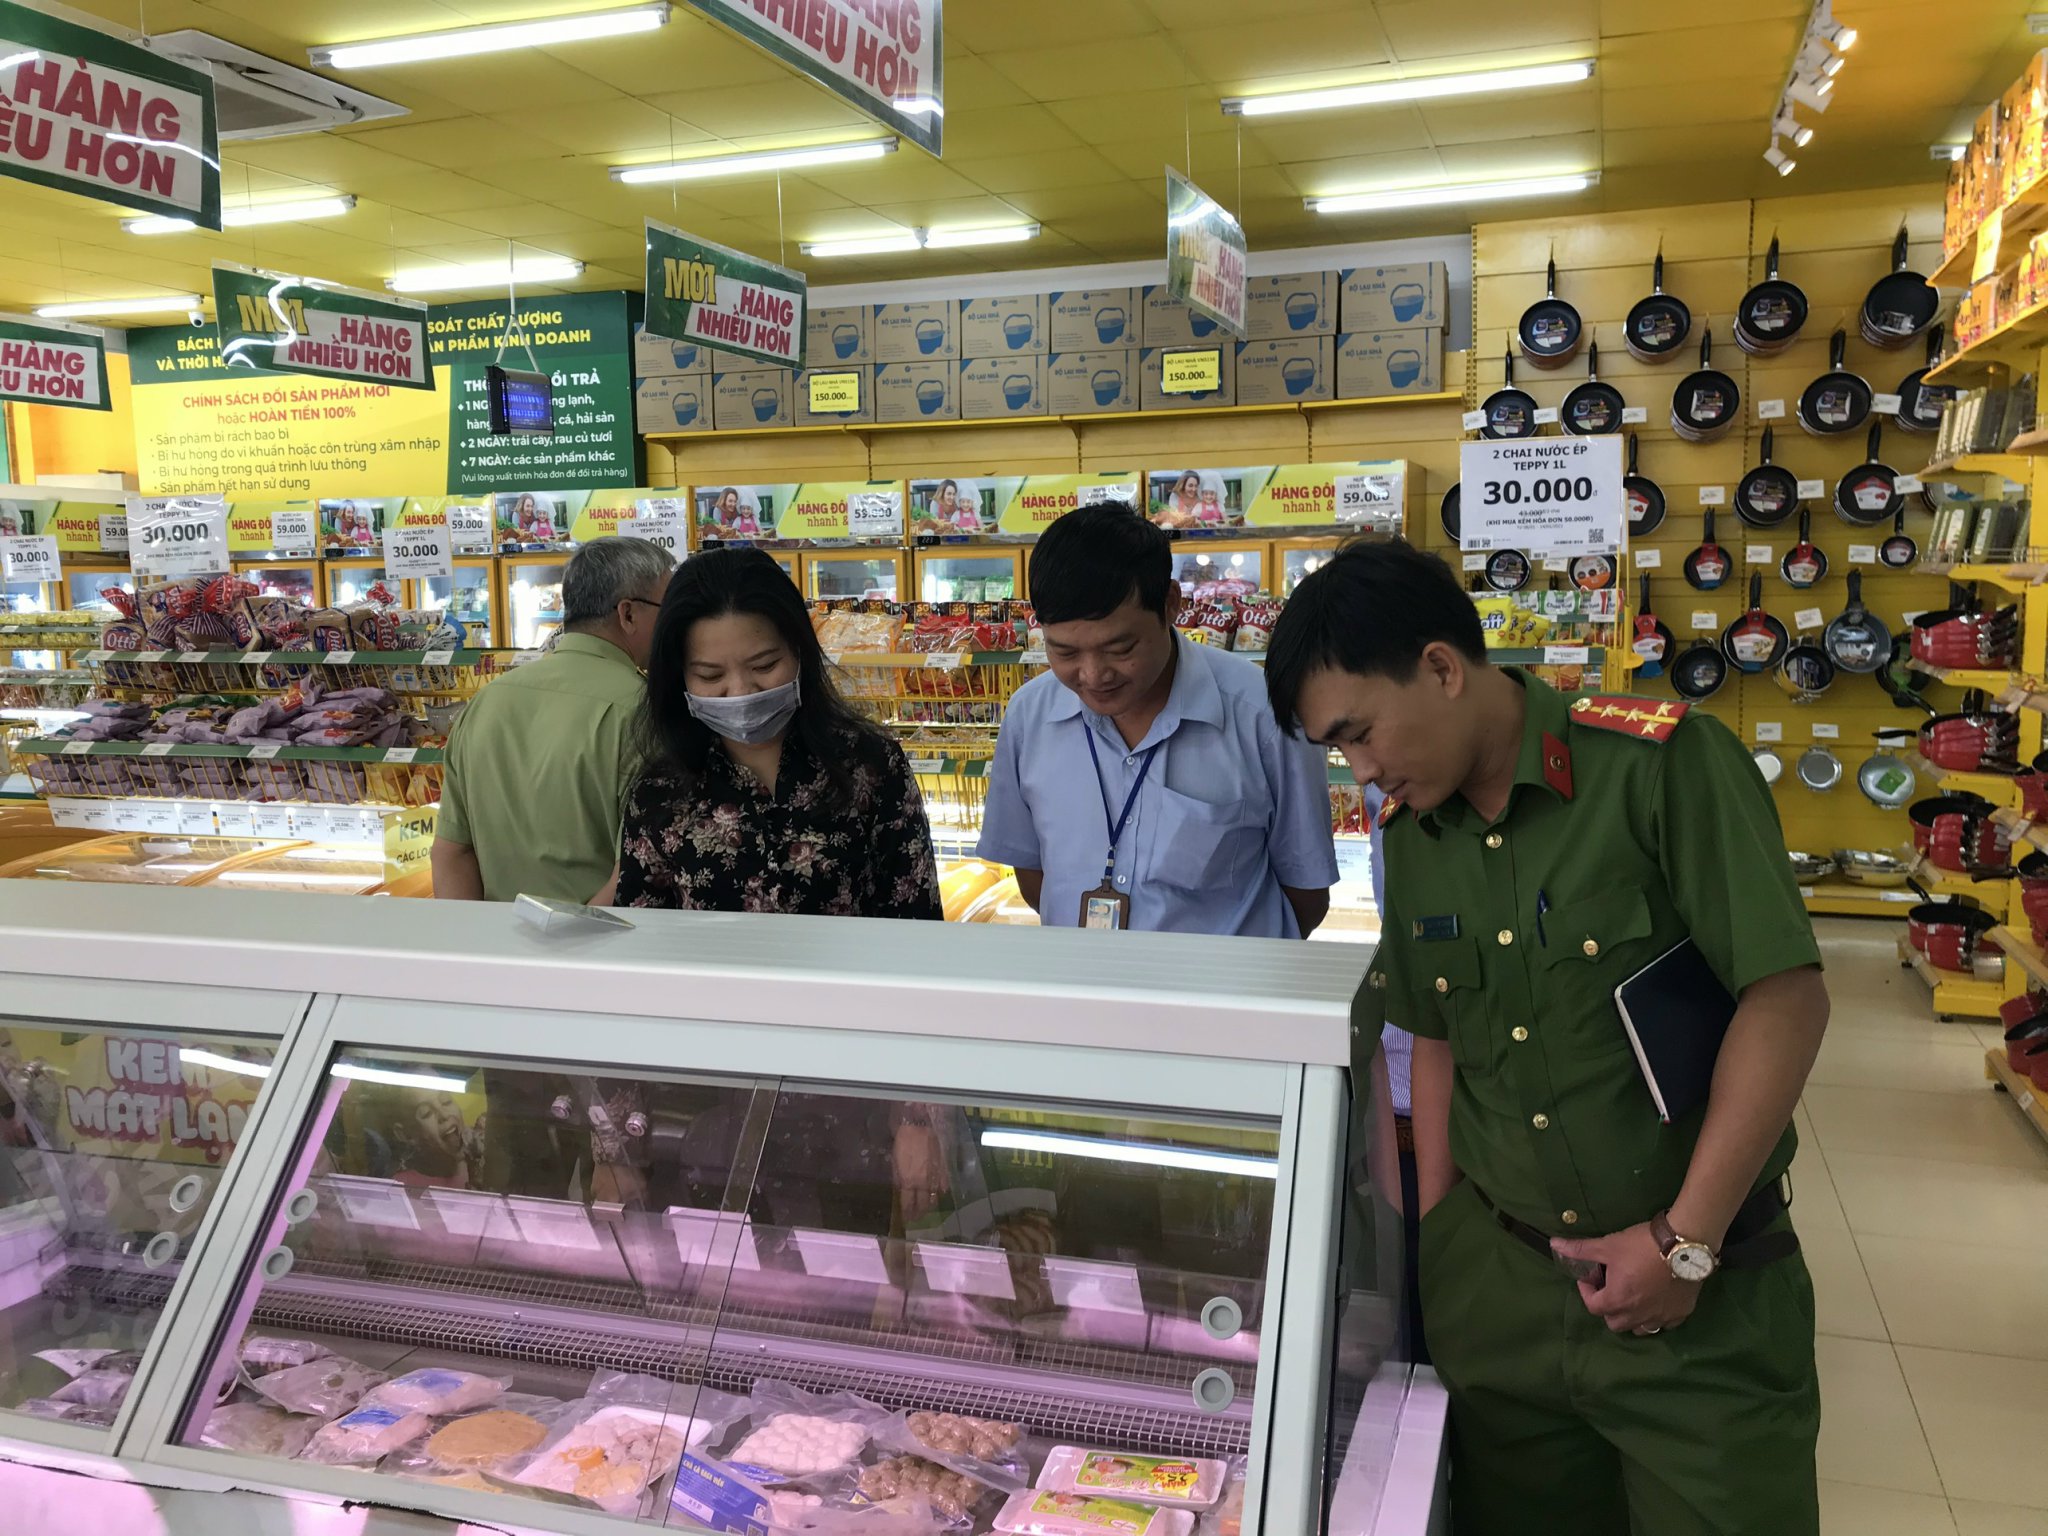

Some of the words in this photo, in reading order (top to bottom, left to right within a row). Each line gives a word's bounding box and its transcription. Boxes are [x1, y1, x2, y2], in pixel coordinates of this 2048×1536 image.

[847, 0, 921, 54] NG
[854, 25, 918, 102] HƠN
[13, 56, 181, 143] HÀNG
[65, 126, 175, 197] HƠN
[663, 254, 717, 305] MỚI
[740, 284, 794, 327] HÀNG
[427, 317, 463, 333] SOÁT
[467, 311, 505, 331] CHẤT
[696, 304, 752, 345] NHIỀU
[753, 323, 791, 355] HƠN
[340, 315, 412, 353] HÀNG
[429, 338, 444, 353] ẢN
[448, 333, 490, 351] PHẨM
[493, 332, 531, 349] KINH
[535, 329, 591, 345] DOANH
[177, 337, 213, 352] BÁCH
[1, 340, 85, 375] HÀNG
[156, 356, 174, 371] VÀ
[180, 354, 209, 369] THỜI
[288, 334, 358, 371] NHIỀU
[364, 350, 411, 378] HƠN
[551, 370, 568, 386] ỔI
[571, 368, 600, 385] TRẢ
[1169, 371, 1205, 381] 150.000
[28, 373, 83, 399] HƠN
[183, 393, 222, 408] CHÍNH
[225, 390, 259, 405] SÁCH
[262, 387, 287, 403] ĐỔI
[321, 383, 360, 399] PHẨM
[568, 394, 595, 407] lạnh,
[815, 392, 847, 401] 150.000
[217, 413, 246, 424] hoặc
[249, 407, 288, 423] HOÀN
[290, 406, 320, 421] TIỀN
[323, 406, 356, 419] 100%
[559, 414, 574, 426] cá,
[577, 412, 592, 423] hải
[595, 412, 615, 423] sản
[254, 429, 275, 440] bao
[468, 438, 475, 448] 2
[477, 435, 510, 447] NGÀY:
[512, 435, 530, 446] trái
[555, 436, 572, 444] rau
[576, 433, 588, 443] củ
[591, 431, 612, 442] tươi
[220, 447, 234, 458] do
[237, 447, 247, 458] vi
[288, 443, 316, 456] hoặc
[320, 442, 341, 454] côn
[344, 440, 376, 454] trùng
[380, 440, 407, 451] xâm
[409, 437, 440, 452] nhập
[1493, 450, 1500, 459] 2
[1503, 448, 1532, 459] CHAI
[1535, 444, 1570, 457] NƯỚC
[1573, 443, 1588, 455] ÉP
[222, 464, 251, 476] trong
[255, 462, 276, 475] quá
[279, 460, 306, 472] trình
[310, 459, 328, 471] lưu
[331, 457, 367, 471] thông
[469, 457, 476, 467] 7
[478, 454, 511, 467] NGÀY:
[513, 455, 531, 465] các
[534, 453, 552, 465] sản
[555, 452, 586, 466] phẩm
[588, 451, 615, 461] khác
[1513, 460, 1549, 471] TEPPY
[1553, 460, 1566, 469] 1L
[279, 476, 310, 490] dụng
[476, 473, 494, 483] lòng
[603, 467, 627, 477] hàng)
[1271, 484, 1310, 500] HÀNG
[1483, 477, 1592, 505] 30.000
[797, 500, 828, 515] HÀNG
[1022, 493, 1056, 509] HÀNG
[1283, 500, 1321, 513] nhanh
[404, 512, 430, 525] HÀNG
[589, 506, 618, 519] HÀNG
[57, 517, 84, 530] HÀNG
[232, 517, 256, 530] HÀNG
[277, 525, 306, 534] 59.000
[452, 520, 483, 529] 59.000
[598, 521, 615, 531] nha
[807, 516, 838, 527] nhanh
[66, 532, 94, 542] nhanh
[142, 523, 209, 544] 30.000
[240, 531, 265, 540] nhanh
[9, 551, 49, 563] 30.000
[393, 544, 438, 558] 30.000
[1197, 613, 1225, 627] Otto
[1243, 609, 1271, 626] Otto
[1480, 615, 1504, 630] aff
[378, 617, 391, 648] Otto
[107, 632, 136, 650] Otto
[400, 816, 433, 842] KEM
[396, 850, 415, 865] CÁC
[66, 1086, 161, 1137] MÁT
[172, 1095, 254, 1163] LẠN
